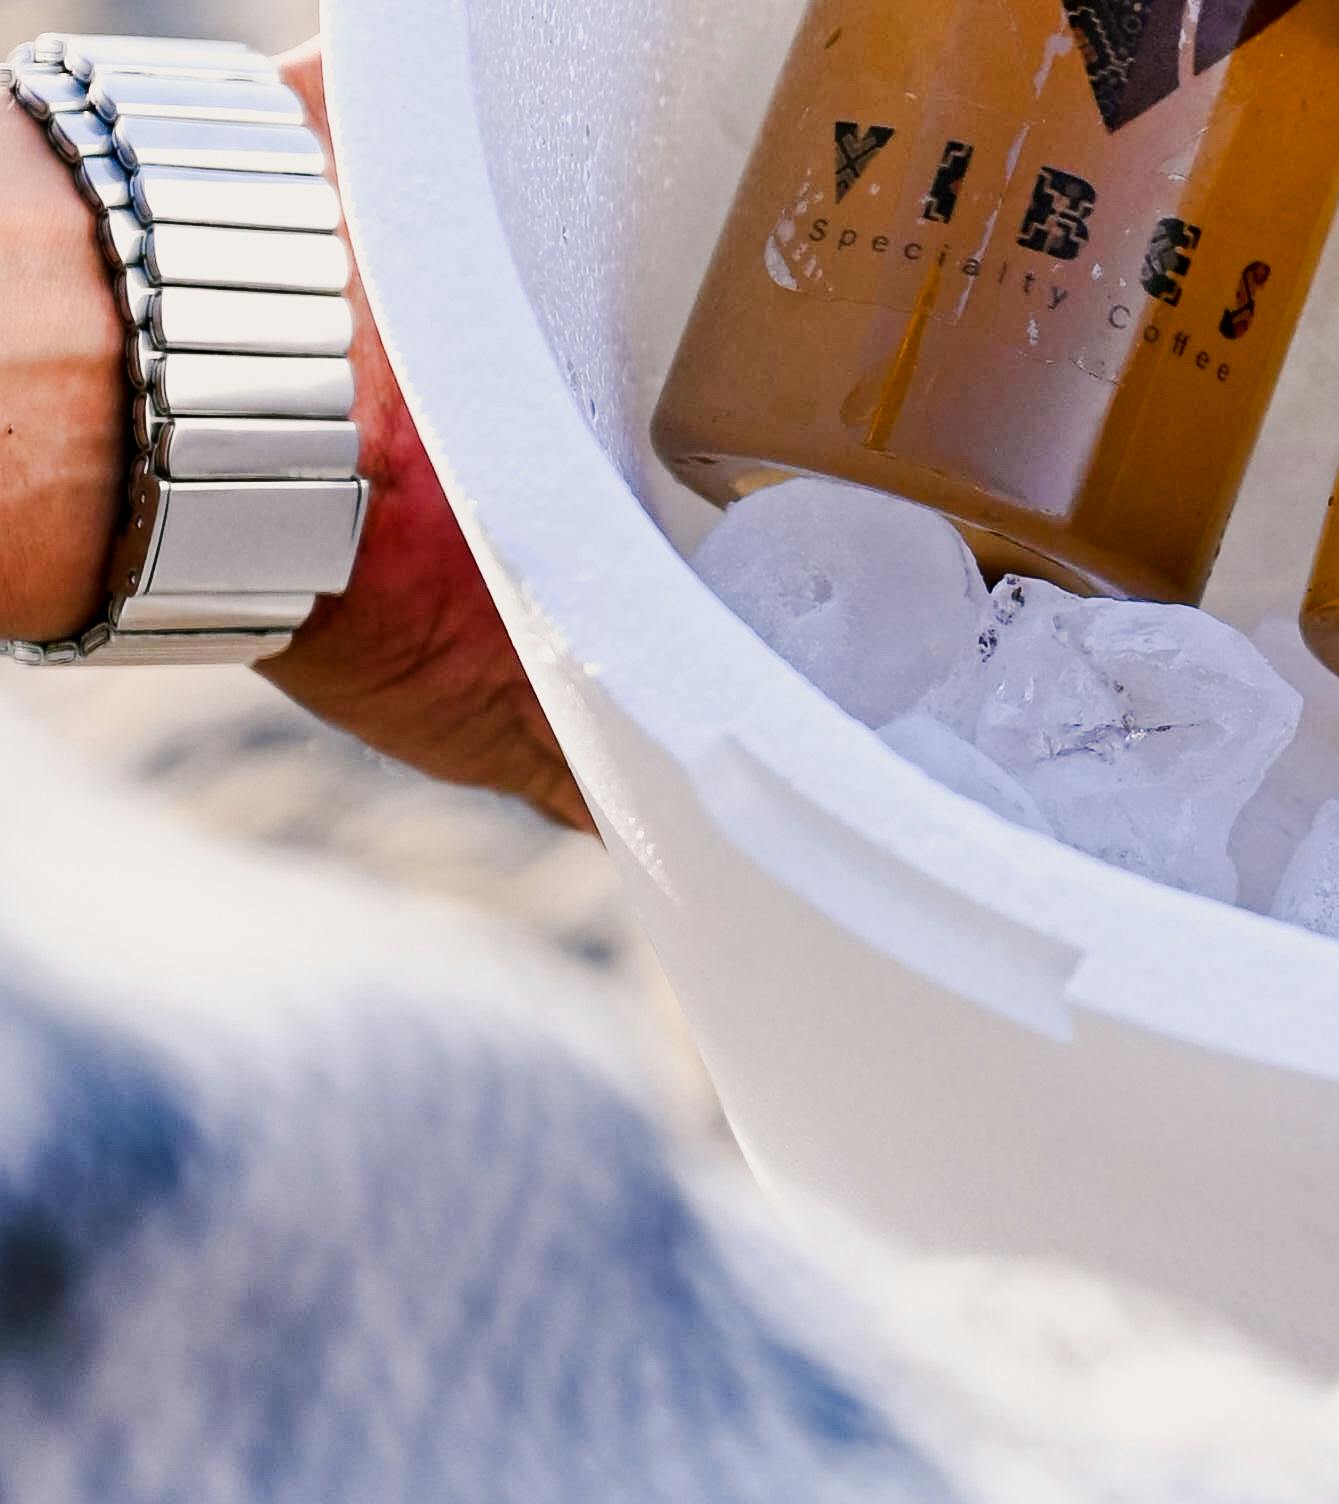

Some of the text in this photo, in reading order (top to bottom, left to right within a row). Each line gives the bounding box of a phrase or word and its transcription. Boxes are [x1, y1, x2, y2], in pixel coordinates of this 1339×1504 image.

[809, 216, 1229, 382] Specialty Coffee
[834, 121, 1271, 340] VIBES
